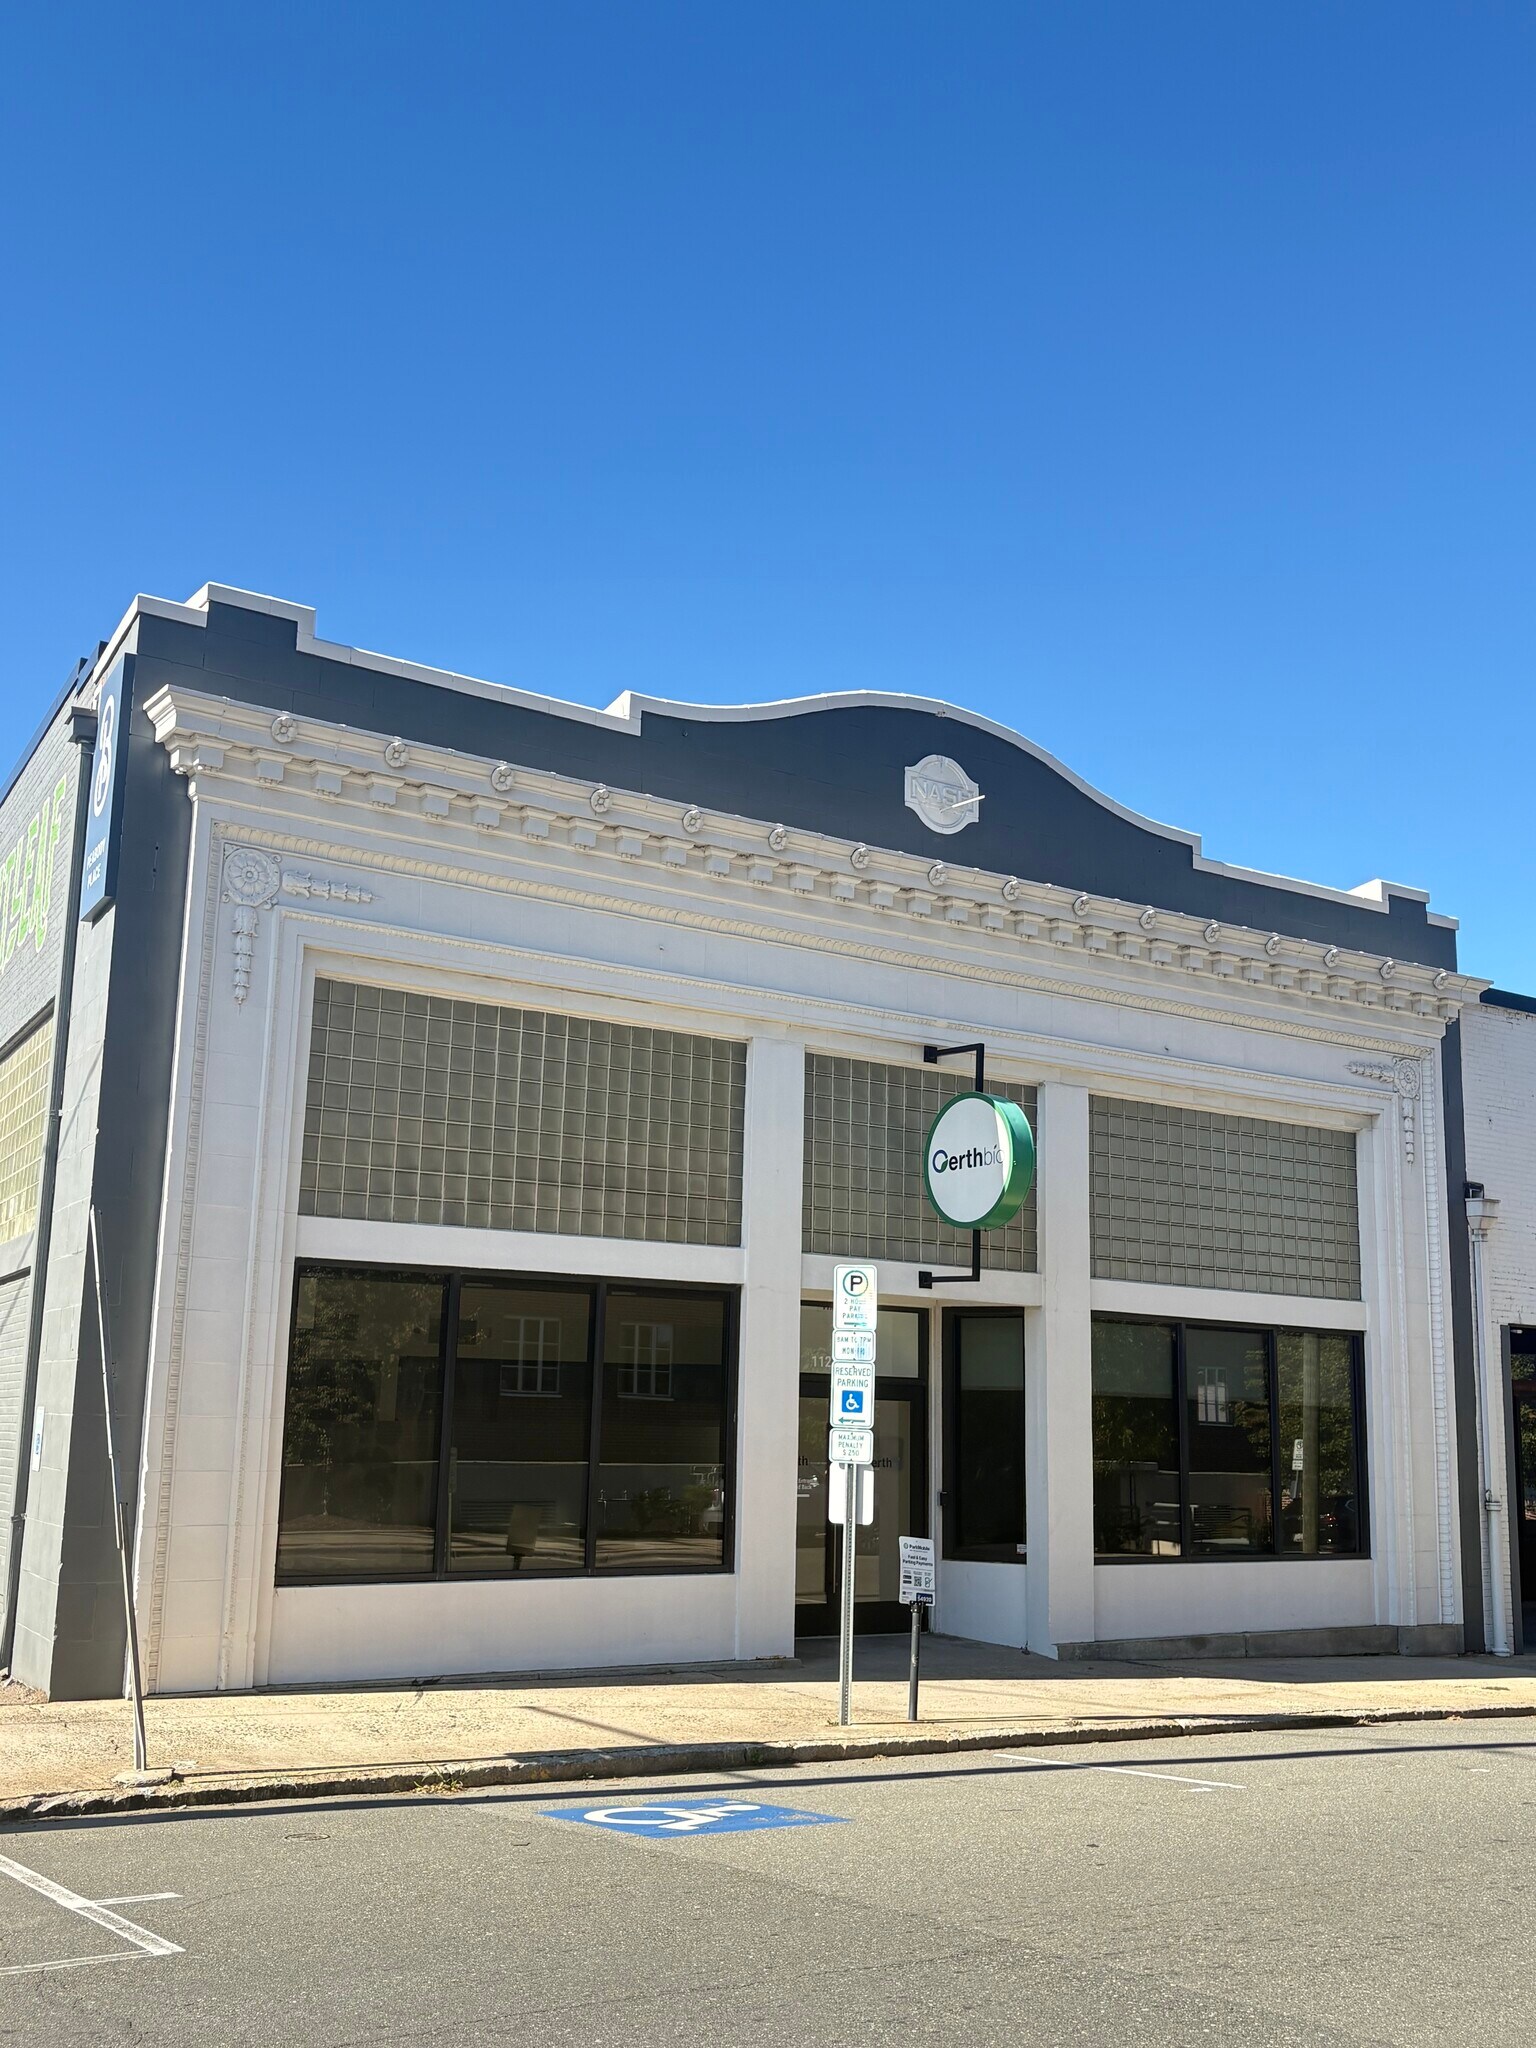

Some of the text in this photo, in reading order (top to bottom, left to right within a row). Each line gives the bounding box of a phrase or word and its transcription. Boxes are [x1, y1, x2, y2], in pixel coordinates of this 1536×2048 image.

[910, 776, 975, 812] NASH
[87, 863, 101, 890] PLACE
[850, 1275, 863, 1291] P
[842, 1312, 868, 1320] PARK
[835, 1367, 872, 1377] RESERVED
[837, 1378, 869, 1388] PARKING
[838, 1441, 863, 1449] PENALTY
[871, 1457, 892, 1468] erth
